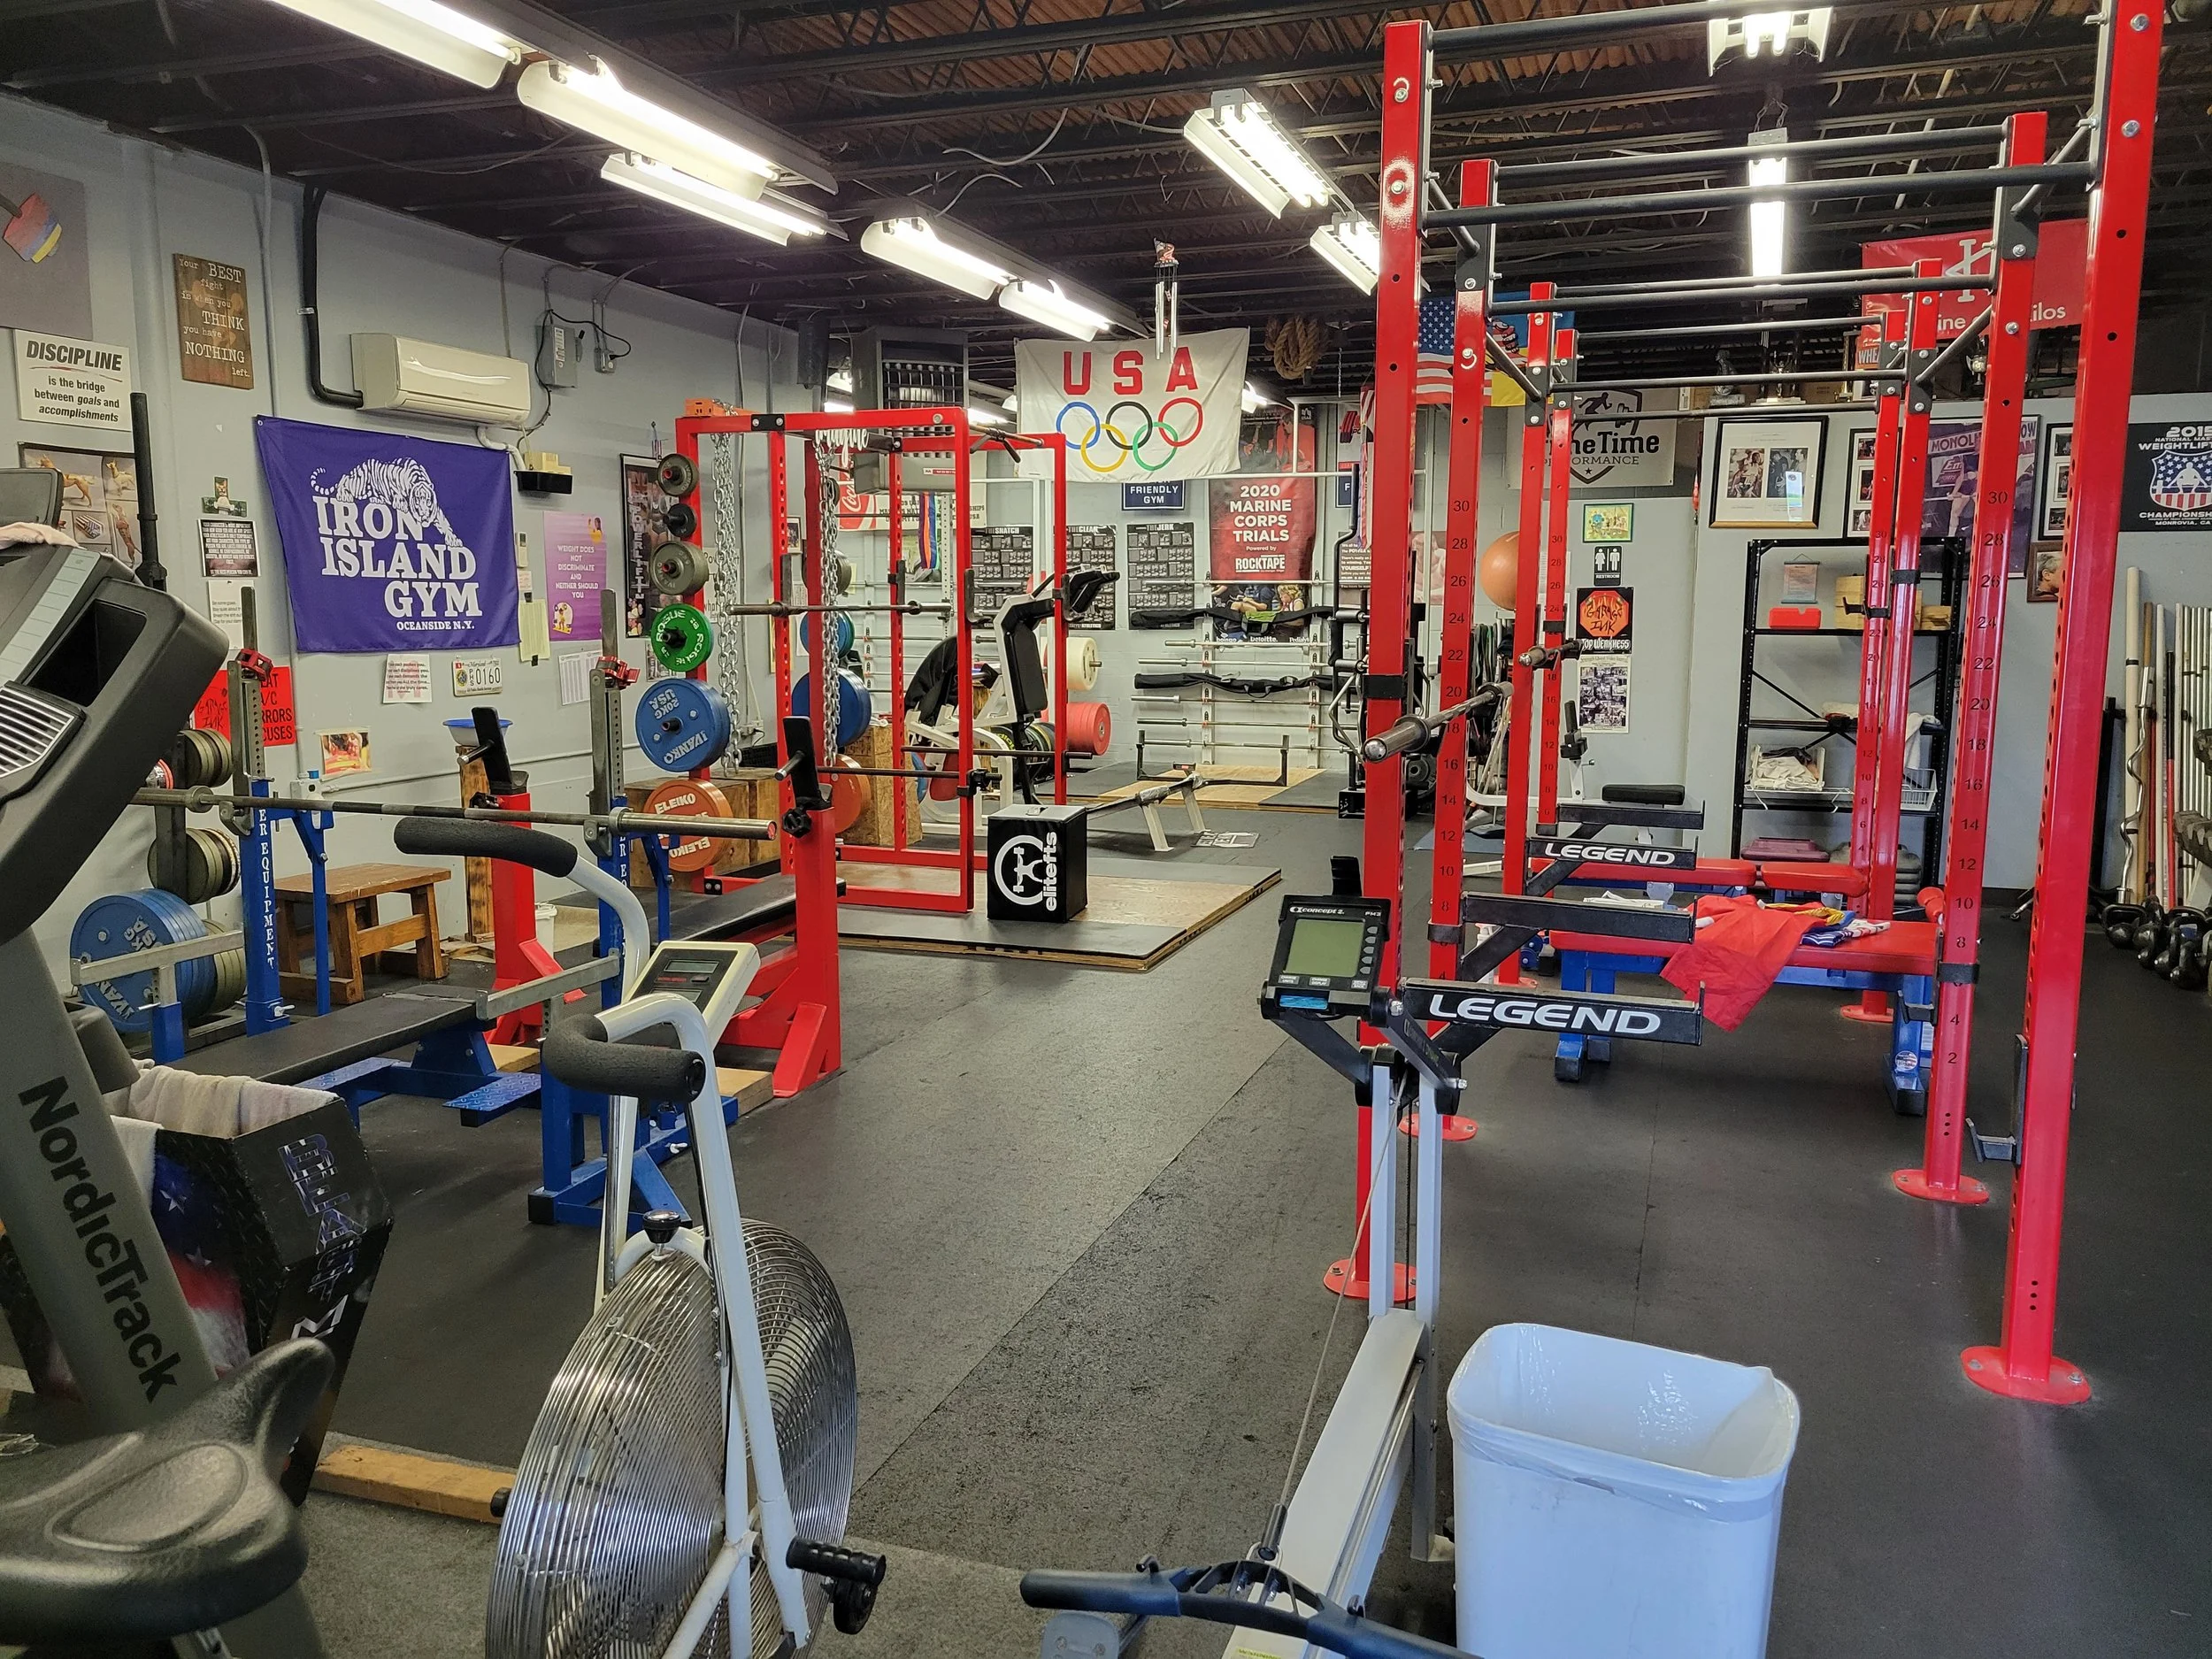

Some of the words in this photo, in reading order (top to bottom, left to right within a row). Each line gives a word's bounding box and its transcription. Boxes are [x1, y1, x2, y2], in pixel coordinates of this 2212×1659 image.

[179, 258, 199, 270] Your
[208, 262, 242, 284] BEST
[200, 279, 223, 291] fight
[181, 290, 191, 301] is
[194, 293, 214, 305] when
[216, 297, 231, 309] you
[2030, 303, 2066, 322] ilos
[202, 310, 244, 331] THINK
[183, 325, 199, 336] you
[202, 326, 222, 339] have
[26, 340, 123, 372] DISCIPLINE
[184, 341, 245, 364] NOTHING
[231, 366, 250, 378] left.
[1064, 346, 1199, 396] USA
[48, 375, 57, 386] is
[59, 377, 74, 388] the
[76, 378, 105, 394] bridge
[34, 388, 74, 403] between
[77, 394, 102, 407] goals
[104, 397, 120, 408] and
[39, 404, 119, 423] accomplishments
[1544, 456, 1640, 465] ORMANCE
[1130, 485, 1179, 495] FRIENDLY
[1240, 484, 1280, 498] 2020
[1143, 495, 1164, 504] GYM
[1987, 491, 2008, 504] 30
[1230, 499, 1292, 513] MARINE
[1453, 501, 1470, 512] 30
[312, 495, 423, 541] IRON
[1233, 515, 1288, 527] CORPS
[1233, 529, 1290, 542] TRIALS
[1985, 533, 2004, 546] 28
[1452, 538, 1468, 549] 28
[319, 536, 477, 580] ISLAND
[1234, 556, 1286, 571] ROCKTAPE
[1450, 575, 1467, 587] 26
[1981, 575, 2001, 588] 26
[384, 580, 482, 618] GYM
[1448, 612, 1464, 624] 24
[1977, 616, 1997, 629] 24
[396, 620, 452, 631] OCEANSIDE
[453, 620, 475, 630] N.Y.
[656, 610, 687, 642] ROGUE
[1590, 620, 1615, 634] INK
[675, 633, 704, 665] ROGUE
[1581, 638, 1594, 650] TOP
[1594, 637, 1631, 651] WEAKNESS
[1448, 649, 1463, 661] 22
[1974, 657, 1993, 670] 22
[476, 667, 501, 685] 0160
[1446, 686, 1462, 697] 20
[649, 688, 677, 710] USA
[1970, 697, 1990, 710] 20
[654, 701, 680, 720] 20KG
[1447, 722, 1460, 733] 18
[664, 729, 709, 764] IVANKO
[1968, 738, 1986, 750] 18
[1443, 759, 1458, 771] 16
[1964, 778, 1983, 791] 16
[655, 793, 696, 814] ELEIKO
[1442, 795, 1456, 806] 14
[1962, 818, 1979, 831] 14
[1440, 830, 1455, 841] 12
[669, 837, 710, 858] ELEIKO
[1544, 842, 1676, 865] LEGEND
[1042, 831, 1058, 911] elitefts
[1440, 865, 1454, 877] 10
[1959, 858, 1977, 871] 12
[261, 842, 275, 970] EQUIPMENT
[1441, 901, 1449, 912] 8
[1955, 897, 1974, 910] 10
[1956, 936, 1966, 949] 8
[1429, 993, 1662, 1035] LEGEND
[1949, 1014, 1960, 1025] 4
[1947, 1052, 1957, 1064] 2
[18, 1075, 181, 1403] NordicTrack
